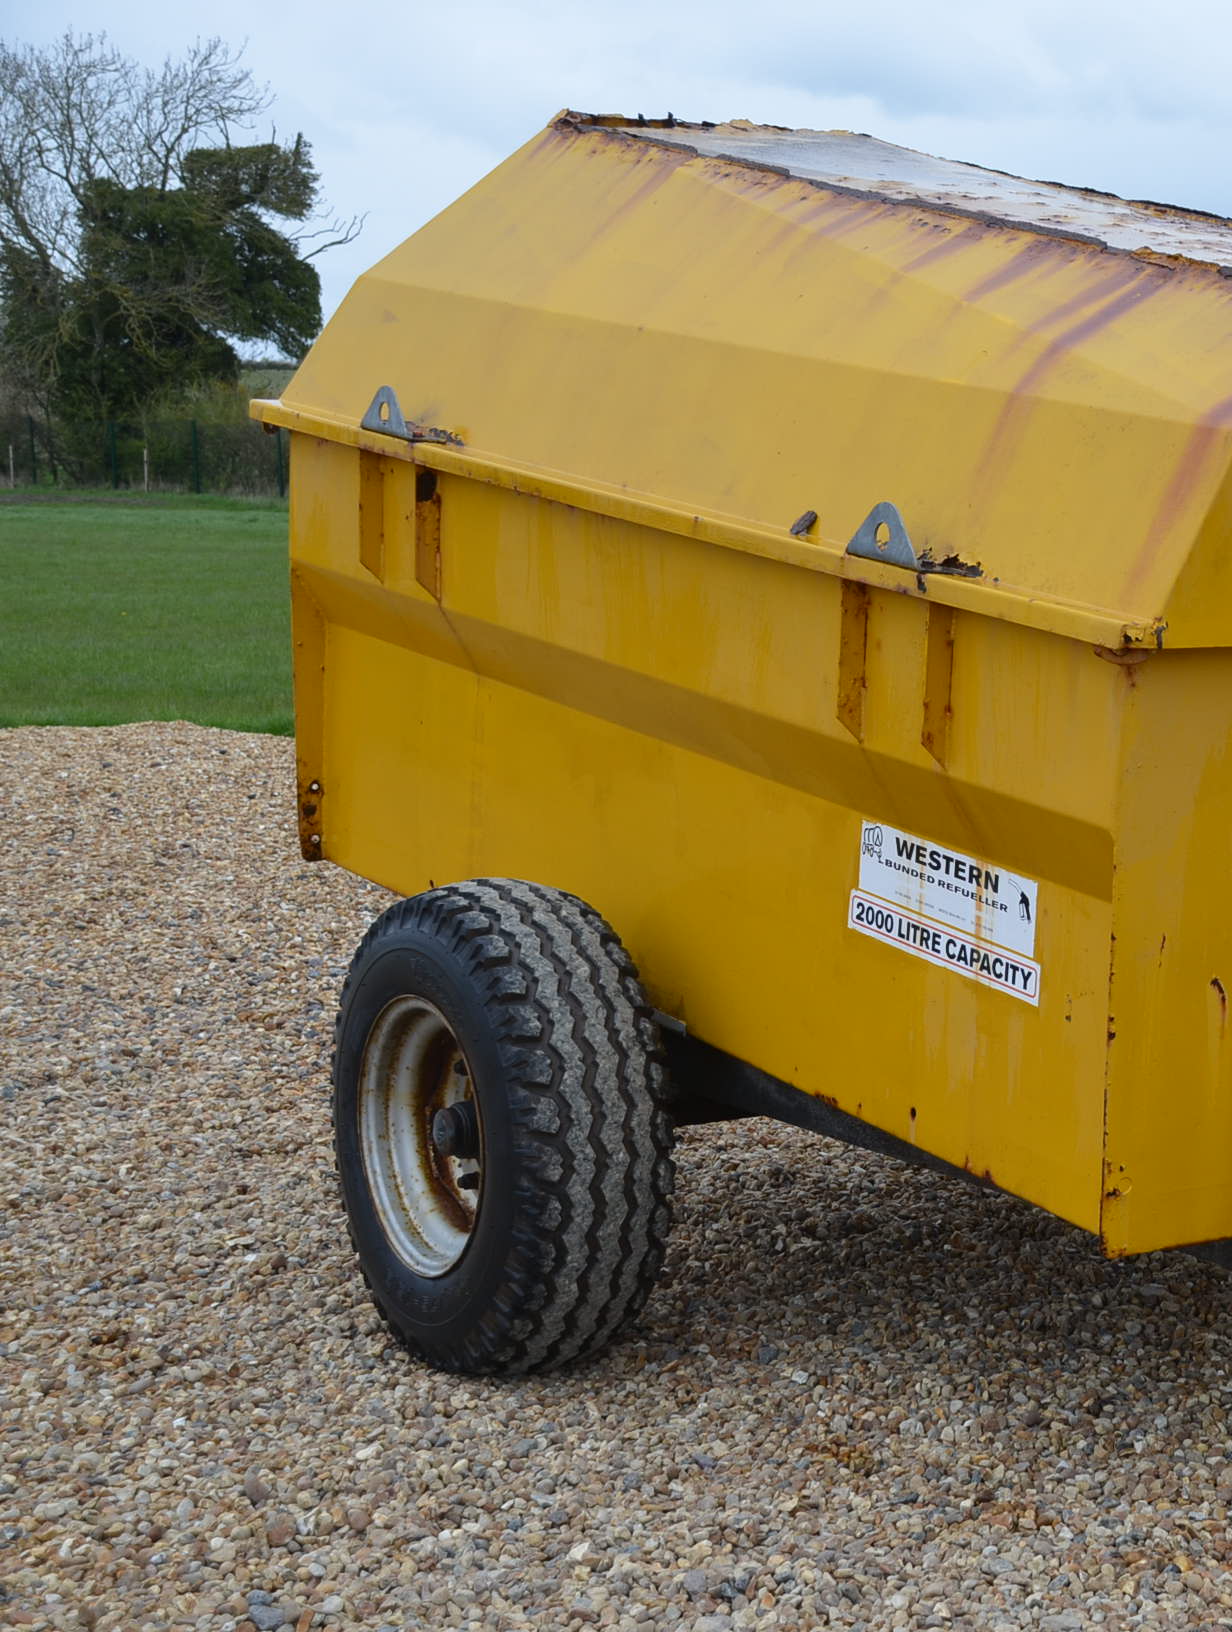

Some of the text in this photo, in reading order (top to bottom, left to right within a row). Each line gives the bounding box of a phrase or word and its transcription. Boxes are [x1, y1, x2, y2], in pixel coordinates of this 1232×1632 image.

[885, 860, 935, 884] BUNDED
[938, 880, 1008, 913] REFUELLER
[895, 836, 999, 893] WESTERN
[855, 902, 894, 934] 2000
[898, 917, 942, 954] LITRE
[945, 938, 1032, 990] CAPACITY
